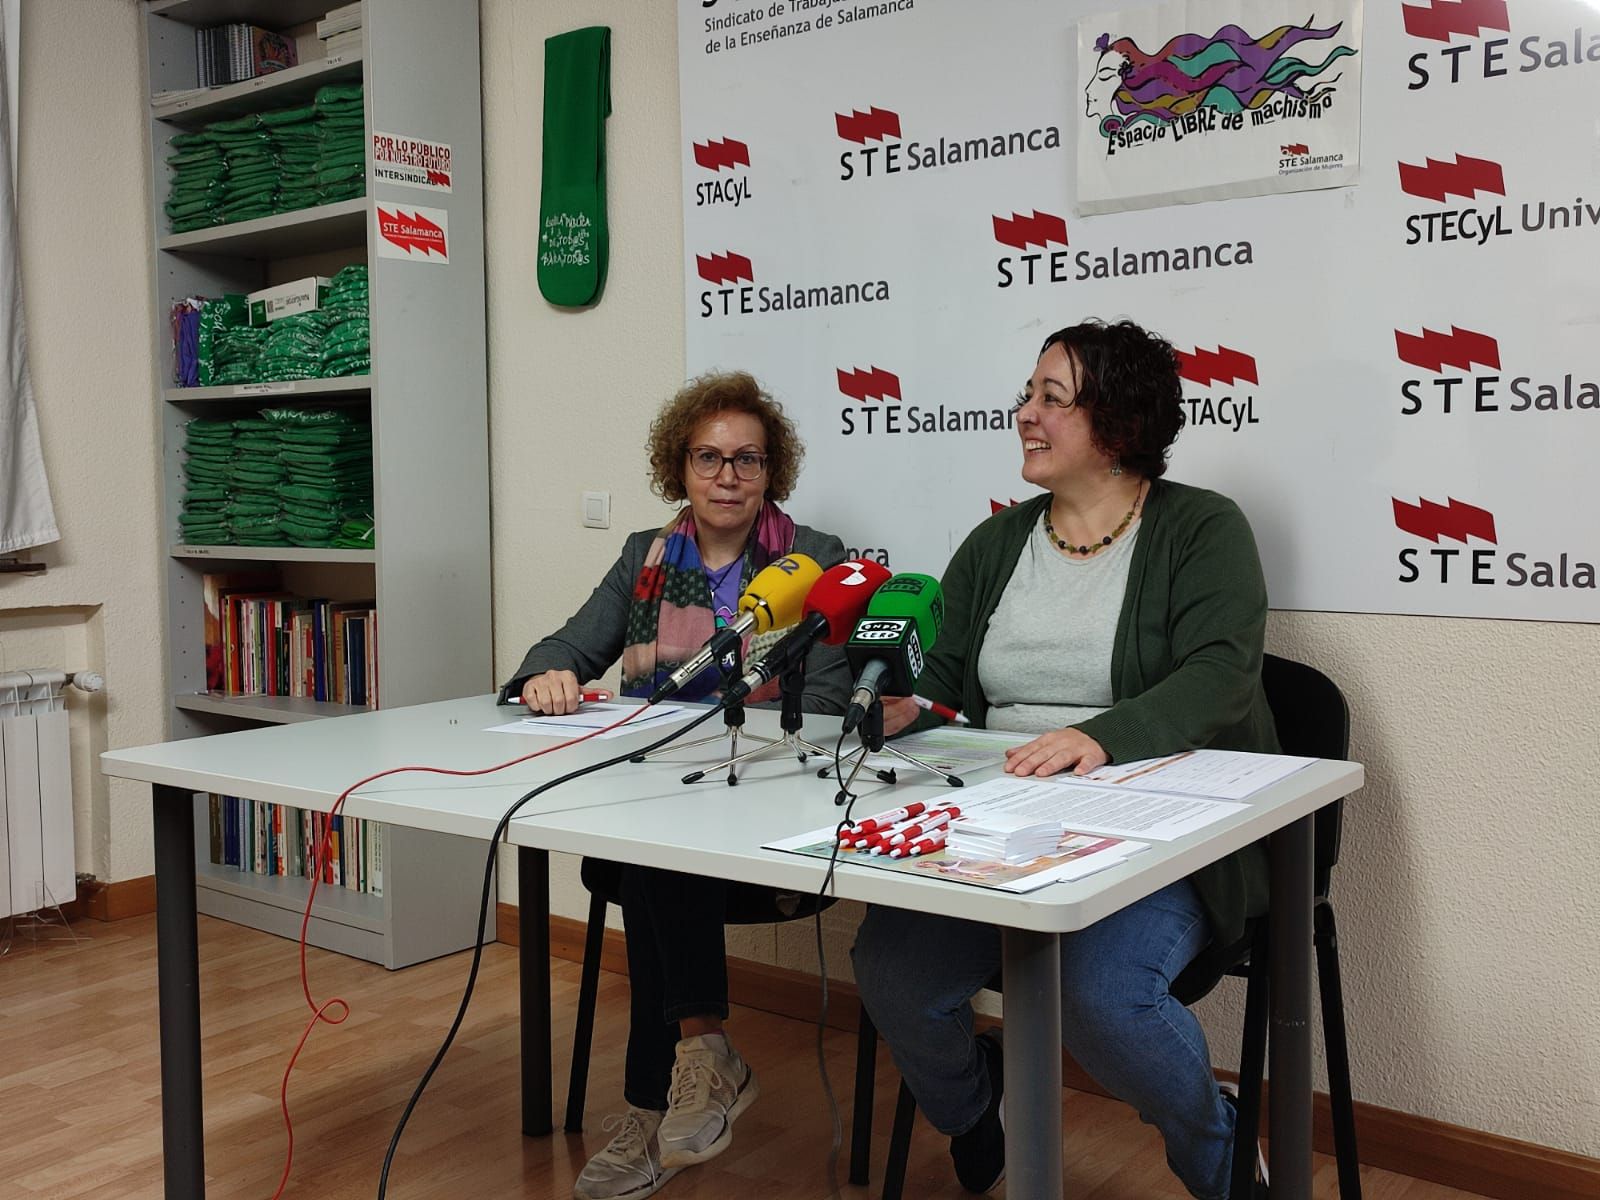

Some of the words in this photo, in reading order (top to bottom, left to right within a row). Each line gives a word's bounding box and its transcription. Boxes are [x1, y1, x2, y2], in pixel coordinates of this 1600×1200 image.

[705, 8, 764, 33] Sindicato
[768, 2, 785, 18] de
[705, 39, 721, 54] de
[725, 35, 736, 50] la
[741, 20, 811, 46] Enseñanza
[816, 13, 833, 30] de
[837, 0, 914, 25] Salamanca
[1408, 38, 1509, 90] STE
[1107, 126, 1166, 155] Espacio
[1171, 106, 1219, 142] LIBRE
[1222, 109, 1244, 131] de
[1252, 93, 1332, 126] machismo
[374, 135, 394, 149] POR
[396, 139, 408, 152] LO
[840, 143, 901, 181] STE
[907, 126, 1061, 171] Salamanca
[1279, 158, 1298, 169] STE
[1300, 154, 1344, 166] Salamanca
[696, 177, 752, 207] STACyL
[383, 222, 399, 233] STE
[401, 224, 443, 238] Salamanca
[1406, 205, 1512, 246] STECyL
[997, 251, 1068, 288] STE
[1075, 241, 1254, 280] Salamanca
[701, 287, 754, 318] STE
[758, 280, 890, 313] Salamanca
[1401, 376, 1500, 415] STE
[841, 405, 901, 435] STE
[1398, 548, 1496, 585] STE
